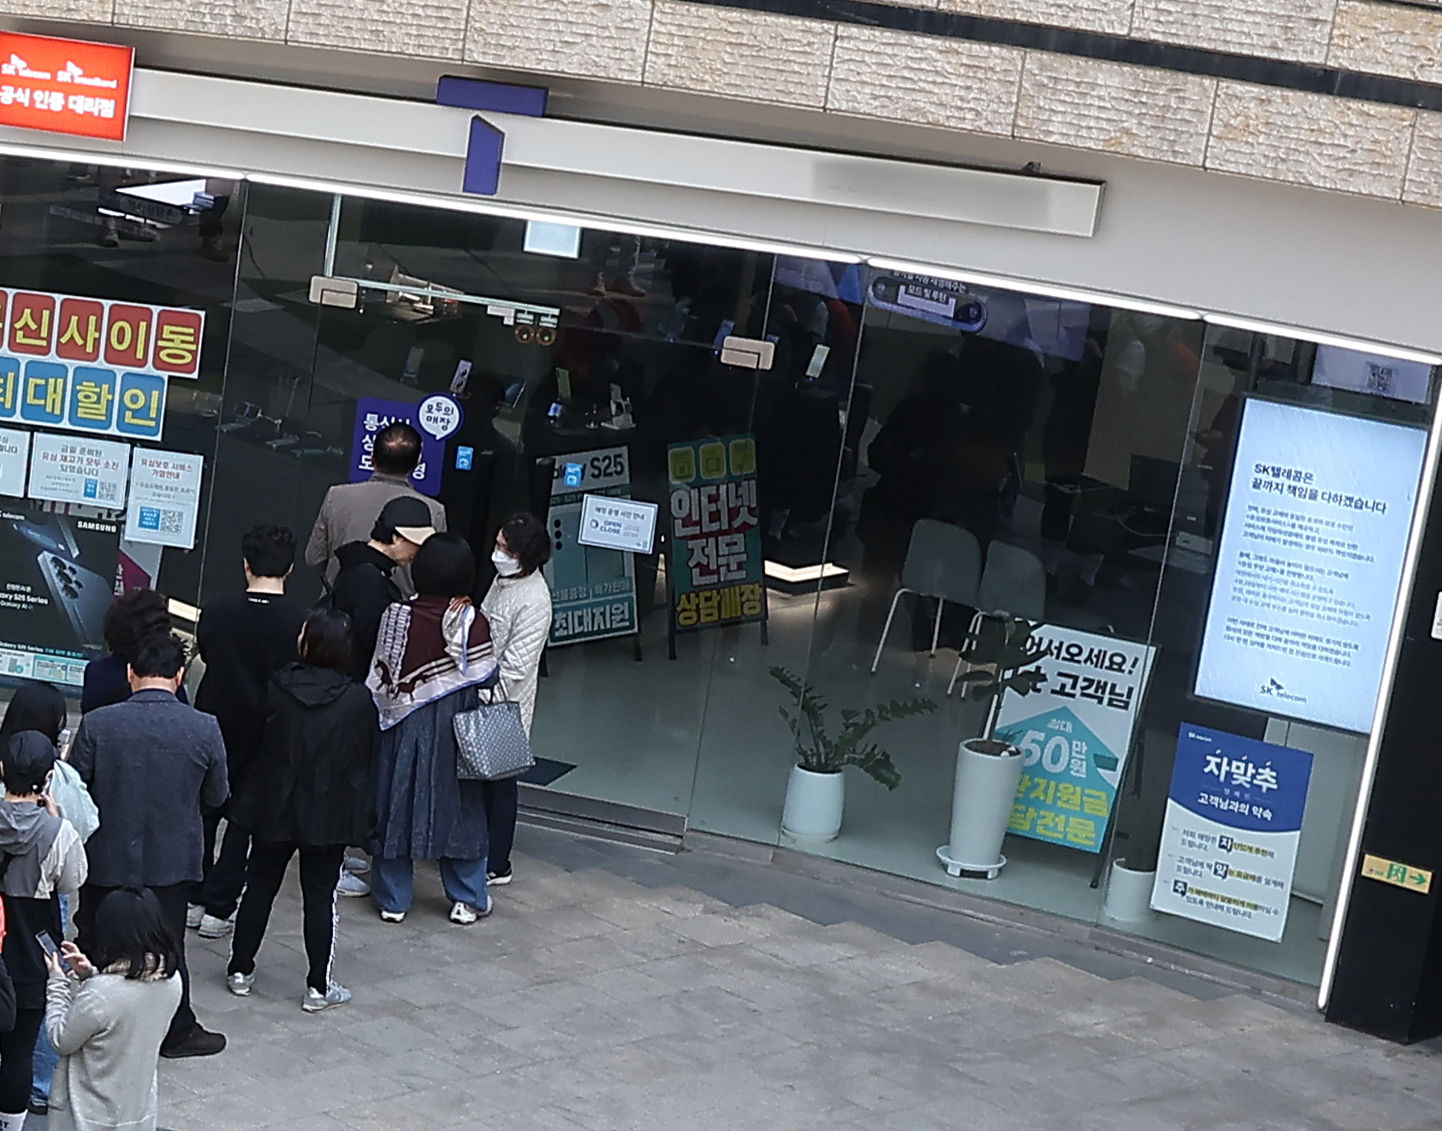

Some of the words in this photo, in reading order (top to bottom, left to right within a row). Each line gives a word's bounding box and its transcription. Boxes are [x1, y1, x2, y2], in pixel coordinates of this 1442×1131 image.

[1, 63, 16, 76] SK
[57, 70, 73, 83] SK
[0, 85, 31, 107] 공식
[33, 90, 65, 111] 인증
[68, 95, 115, 118] 대리점
[425, 402, 454, 416] 모두의
[426, 415, 451, 431] 매장
[590, 454, 624, 479] S25
[1254, 463, 1314, 485] SK텔레콤은
[671, 479, 758, 537] 인터넷
[1252, 477, 1284, 495] 끝까지
[1286, 483, 1319, 502] 책임을
[1321, 490, 1387, 514] 다하겠습니다
[77, 521, 118, 533] SAMSUNG
[603, 520, 622, 528] OPEN
[687, 532, 748, 587] 전문
[27, 594, 49, 605] Series
[676, 583, 764, 628] 상담매장
[554, 602, 631, 637] 최대지원
[1027, 634, 1140, 675] 어서오세요!
[1050, 671, 1135, 711] 고객님
[1260, 685, 1273, 695] SK
[1276, 691, 1307, 703] telecom
[1022, 729, 1070, 775] 50
[1203, 750, 1279, 794] 자맞추
[1198, 792, 1250, 817] 고객님과의
[1252, 805, 1273, 822] 약속
[1008, 807, 1097, 846] 담전문
